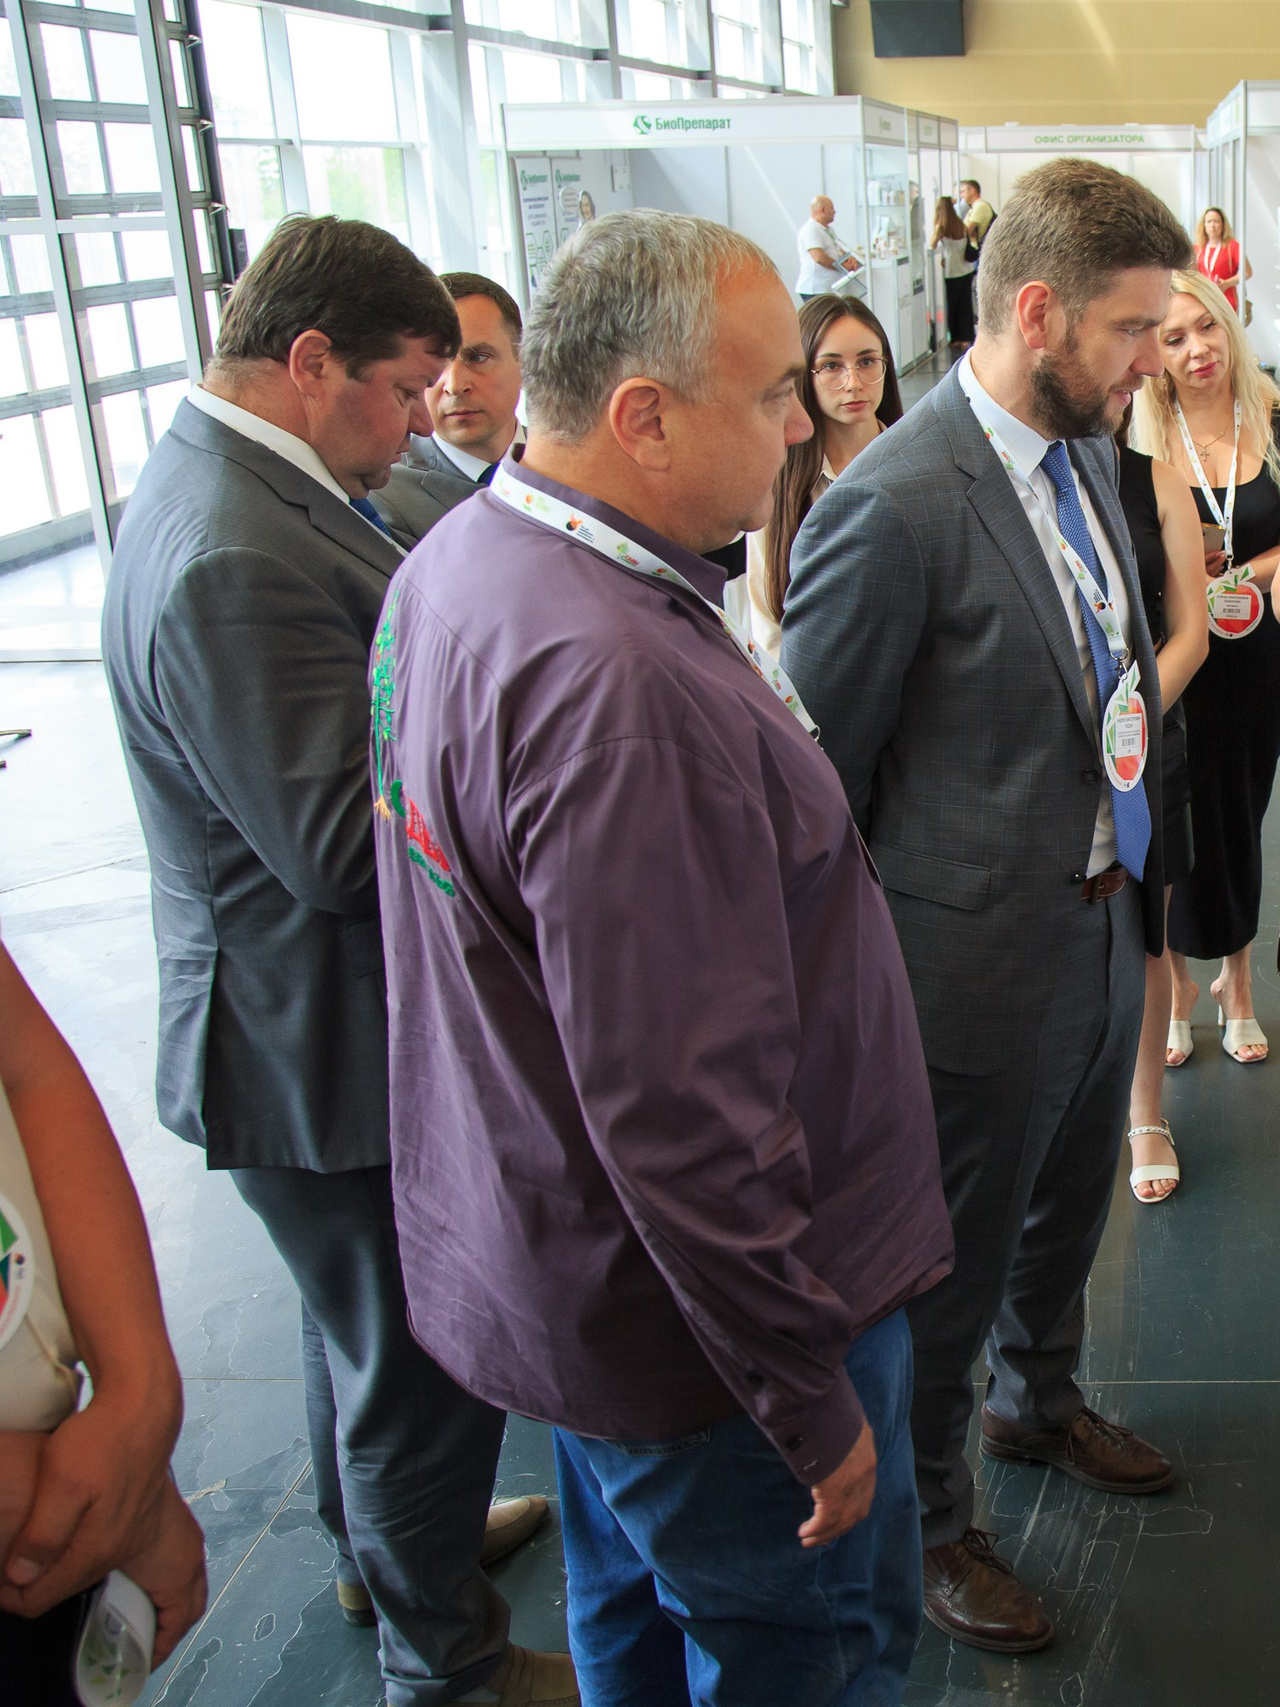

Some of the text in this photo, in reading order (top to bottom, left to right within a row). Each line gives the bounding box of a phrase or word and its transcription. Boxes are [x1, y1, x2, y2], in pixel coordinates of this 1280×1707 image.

[655, 117, 732, 132] БиоПрепарат
[1034, 134, 1145, 144] ОФИС ОРГАНИЗАТОРА
